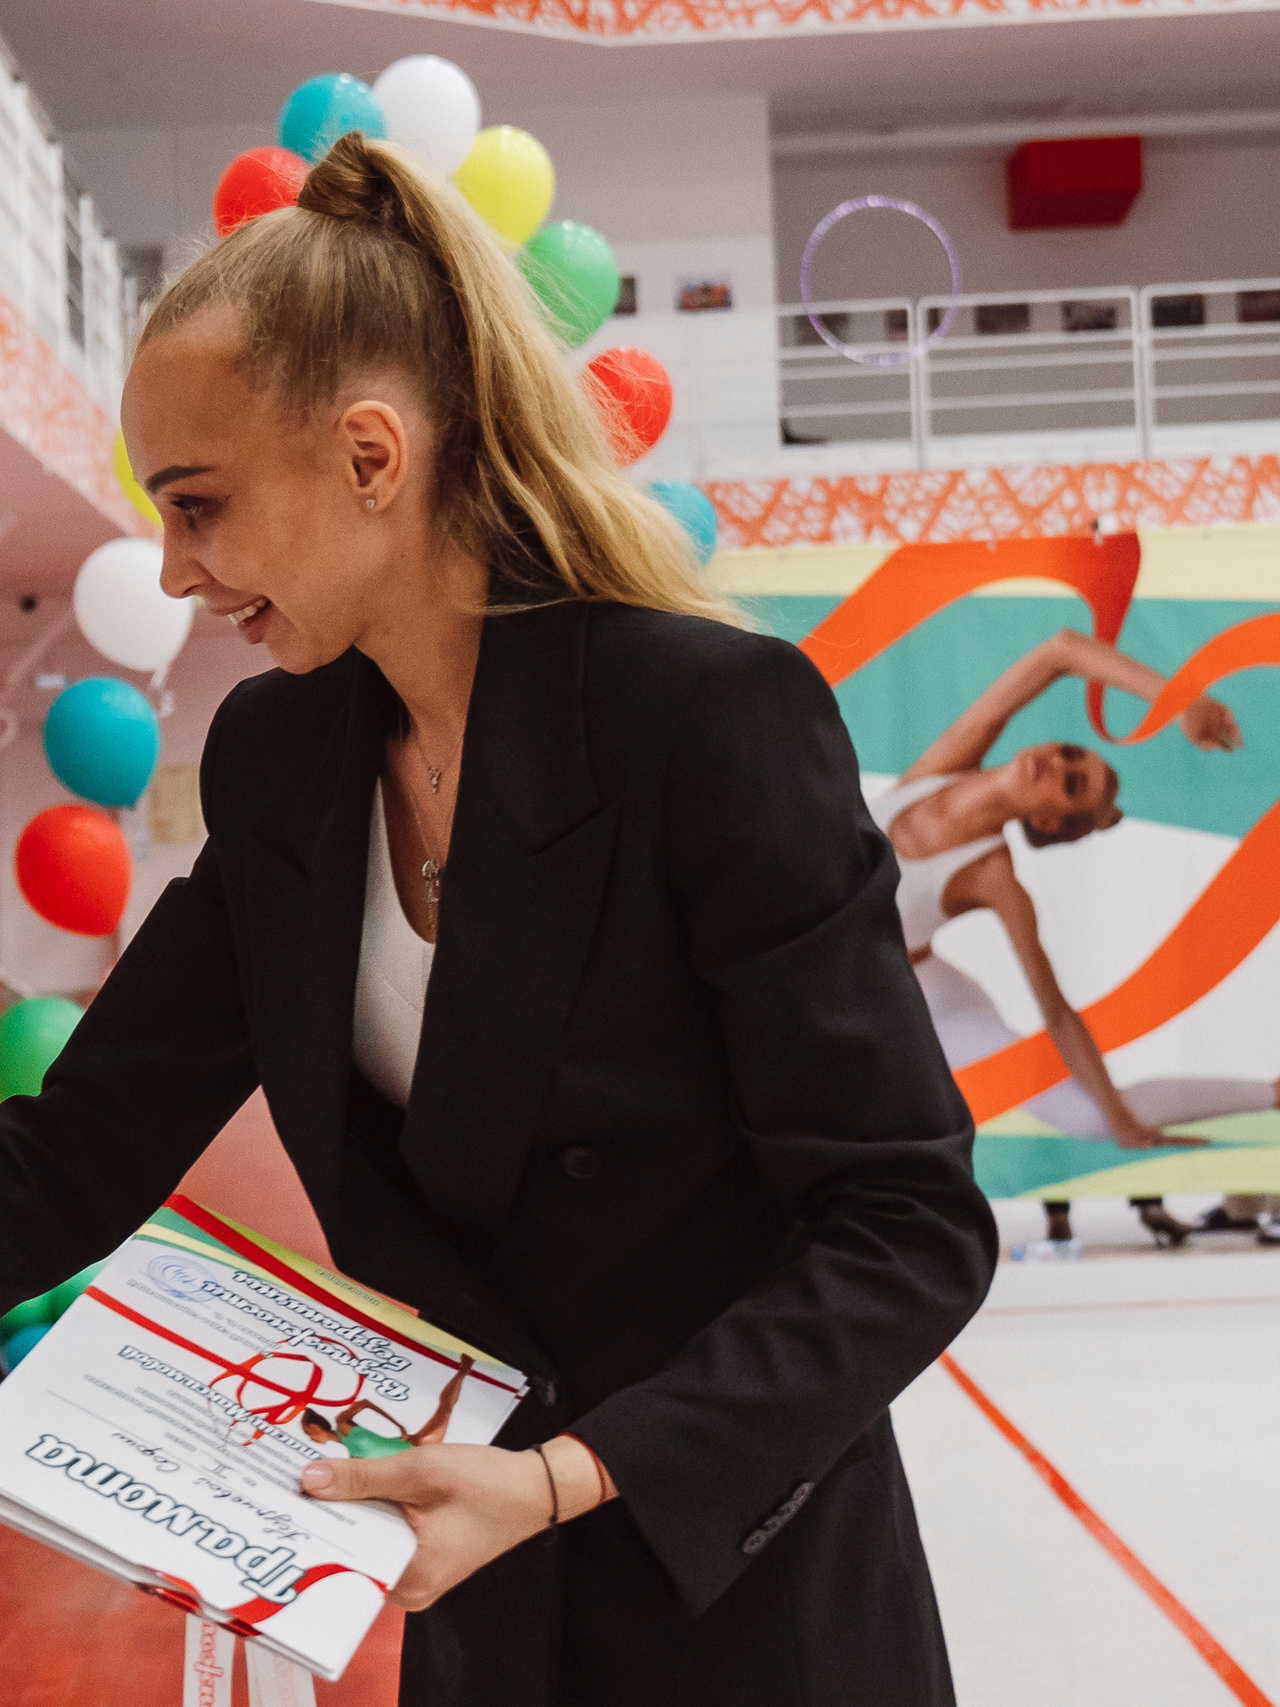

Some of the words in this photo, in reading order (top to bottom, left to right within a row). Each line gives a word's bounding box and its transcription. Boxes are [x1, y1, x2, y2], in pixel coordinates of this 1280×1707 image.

[196, 1280, 411, 1402] Возможности
[231, 1266, 413, 1373] безграничны
[117, 1344, 251, 1419] Максимовой
[24, 1433, 306, 1606] Грамота
